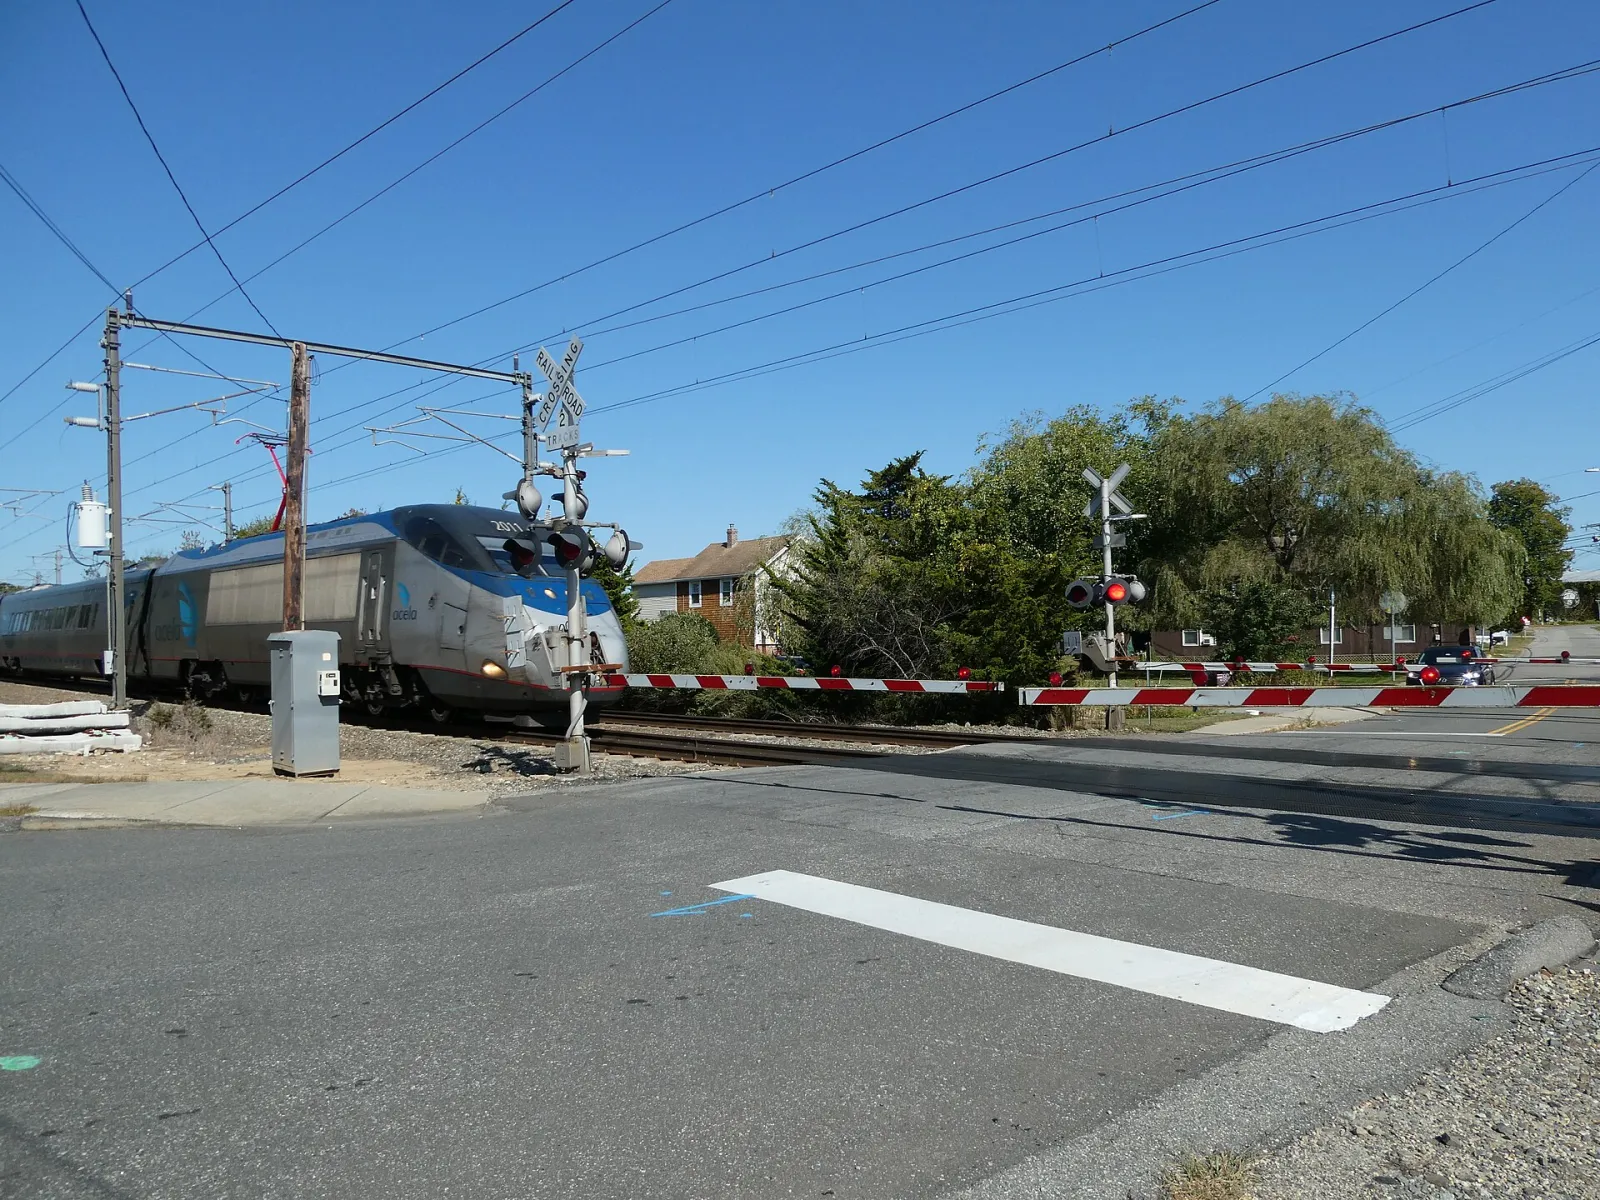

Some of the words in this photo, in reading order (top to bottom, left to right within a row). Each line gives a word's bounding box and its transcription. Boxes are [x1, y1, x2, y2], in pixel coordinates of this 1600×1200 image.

[536, 351, 555, 381] RAIL
[562, 386, 583, 417] ROAD
[539, 342, 579, 423] CROSSING
[559, 413, 566, 427] 2
[547, 429, 579, 446] TRACKS
[490, 520, 524, 532] 2011
[392, 605, 418, 621] acela
